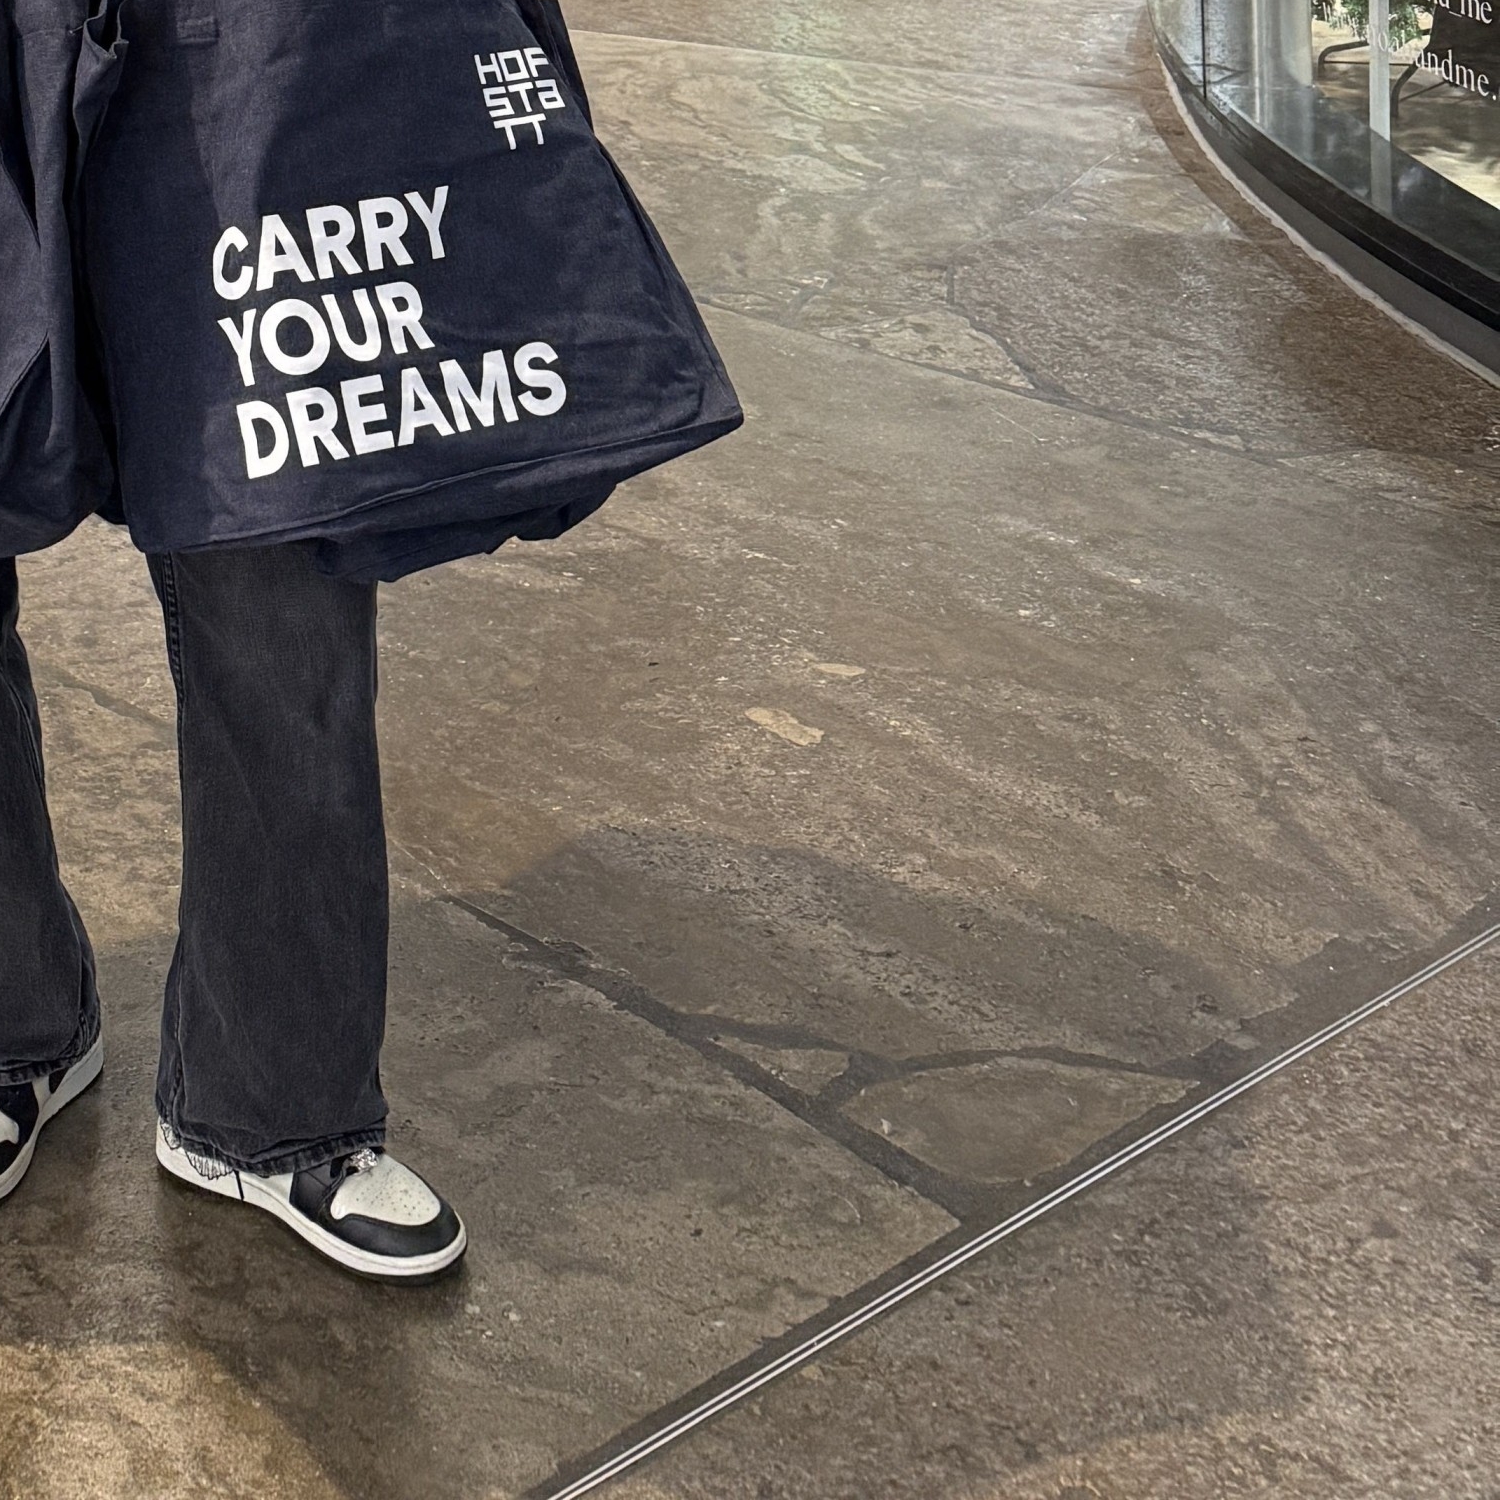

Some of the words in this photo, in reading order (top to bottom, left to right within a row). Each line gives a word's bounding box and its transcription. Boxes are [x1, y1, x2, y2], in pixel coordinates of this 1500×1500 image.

[474, 47, 550, 85] HOF
[213, 185, 449, 300] CARRY
[217, 281, 435, 387] YOUR
[236, 341, 567, 479] DREAMS
